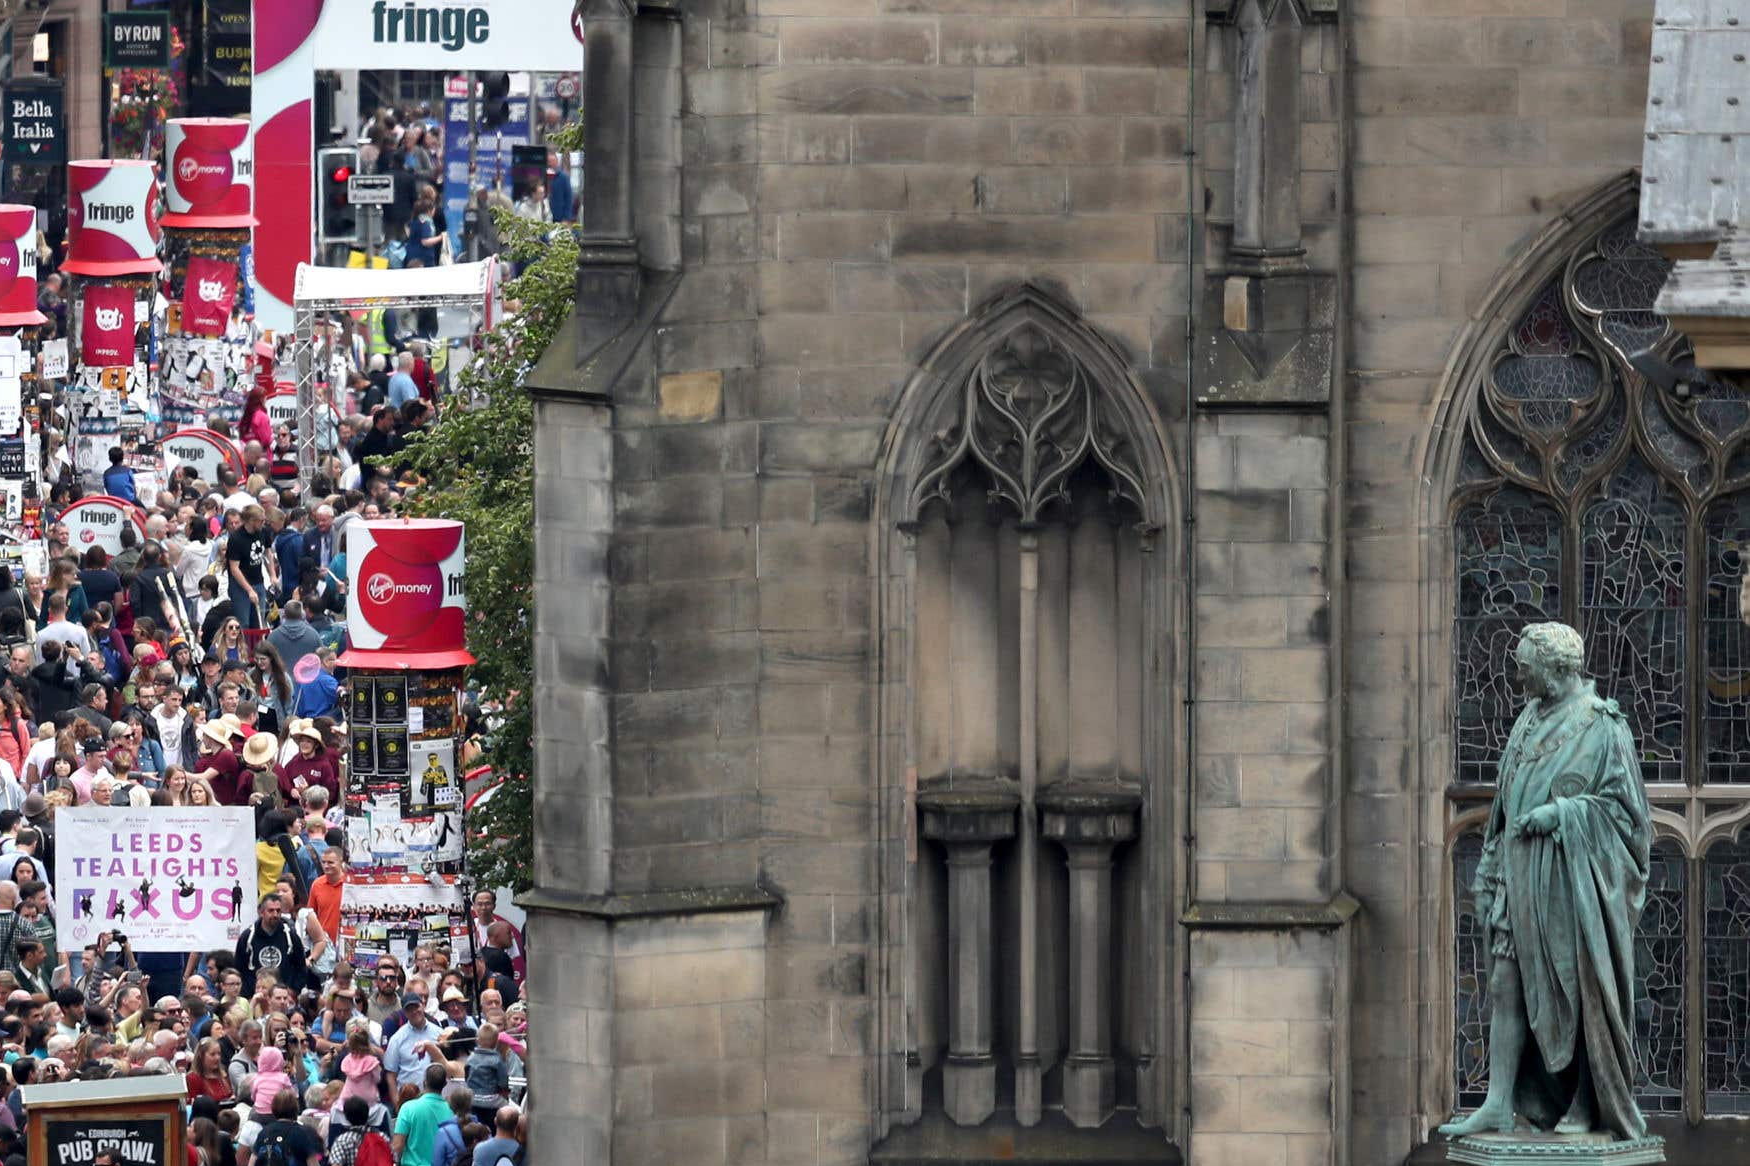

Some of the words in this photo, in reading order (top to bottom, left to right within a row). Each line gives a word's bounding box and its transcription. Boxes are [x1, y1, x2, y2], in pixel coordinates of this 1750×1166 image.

[114, 24, 161, 42] BYRON
[371, 1, 490, 52] fringe
[11, 101, 53, 118] Bella
[11, 122, 55, 139] Italia
[199, 165, 226, 176] money
[88, 202, 134, 224] fringe
[270, 405, 299, 420] fring
[169, 445, 205, 461] fringe
[80, 510, 117, 526] fringe
[369, 577, 394, 599] Virgin
[395, 584, 432, 595] money
[111, 833, 203, 853] LEEDS
[73, 857, 239, 877] TEALIGHTS
[88, 1129, 126, 1138] EDINBURGH
[57, 1140, 94, 1165] PUB
